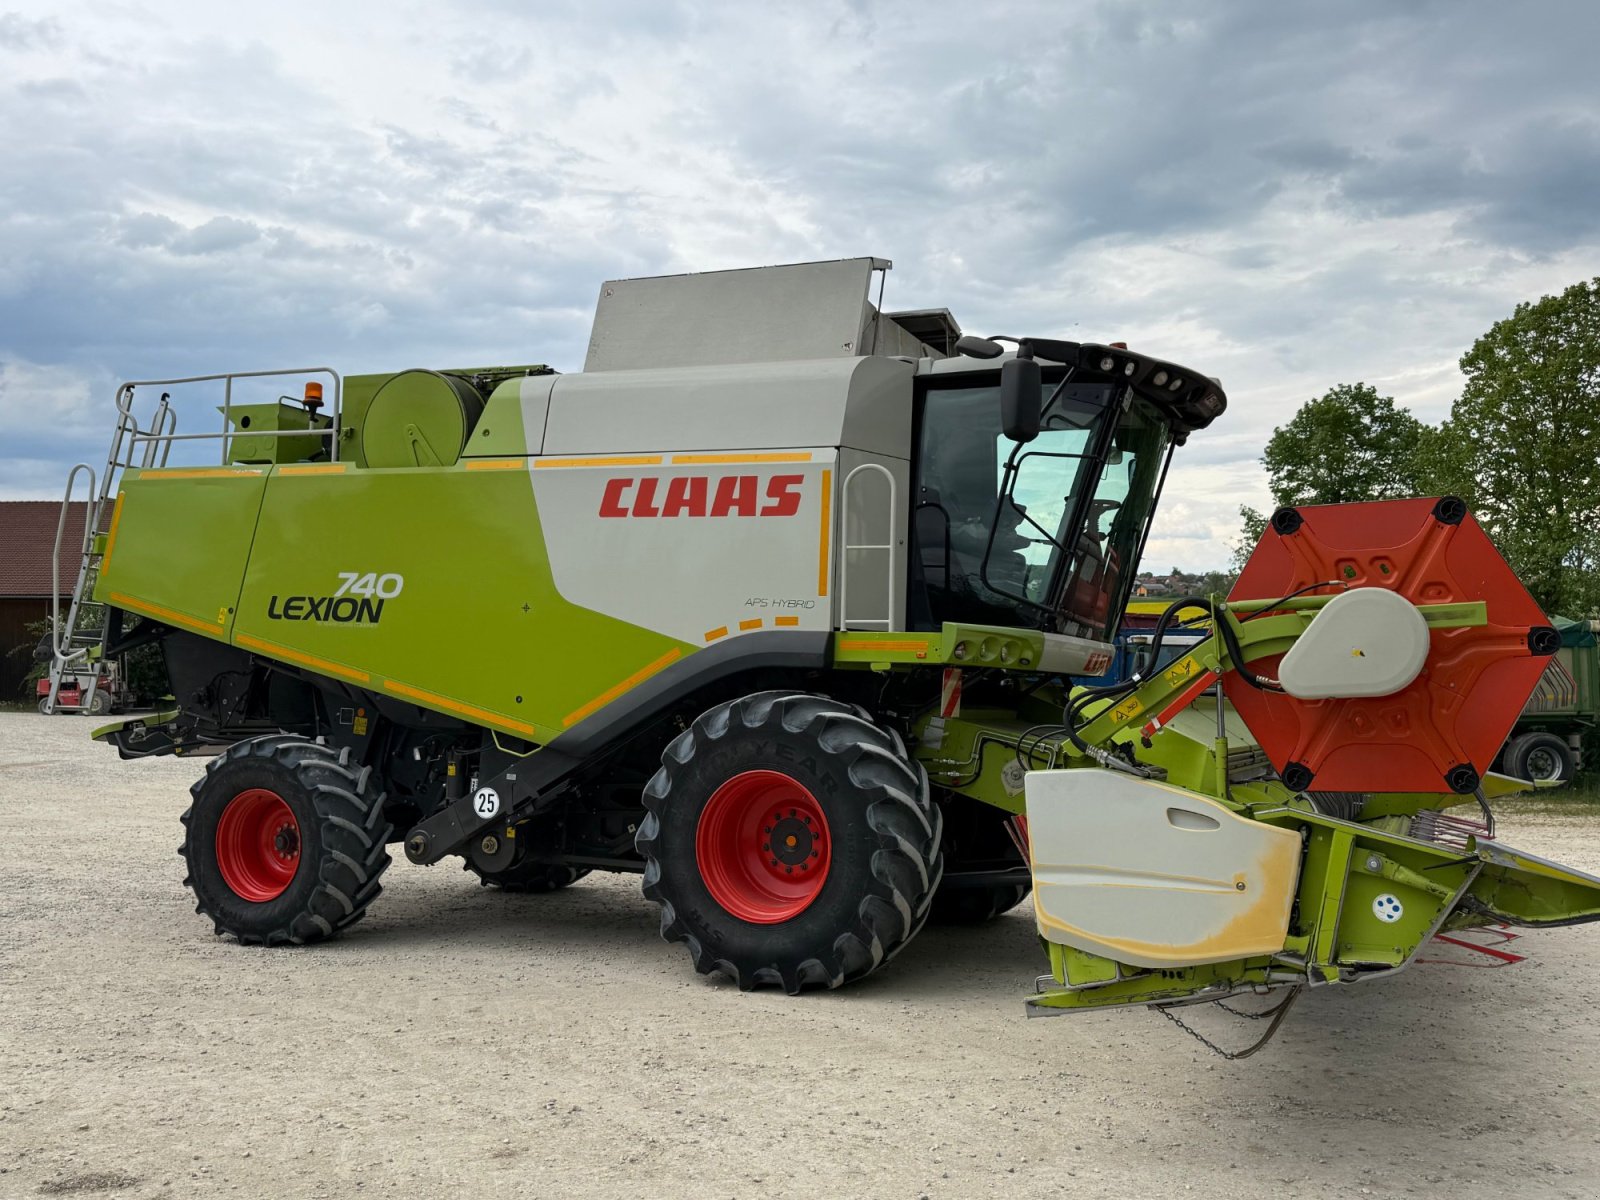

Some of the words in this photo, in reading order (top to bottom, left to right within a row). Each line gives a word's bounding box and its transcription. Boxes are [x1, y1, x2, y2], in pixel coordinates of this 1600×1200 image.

[599, 474, 805, 518] CLAAS
[334, 572, 404, 599] 740
[268, 595, 385, 623] LEXION
[744, 597, 769, 608] APS
[772, 598, 815, 609] HYBRID
[478, 793, 495, 813] 25
